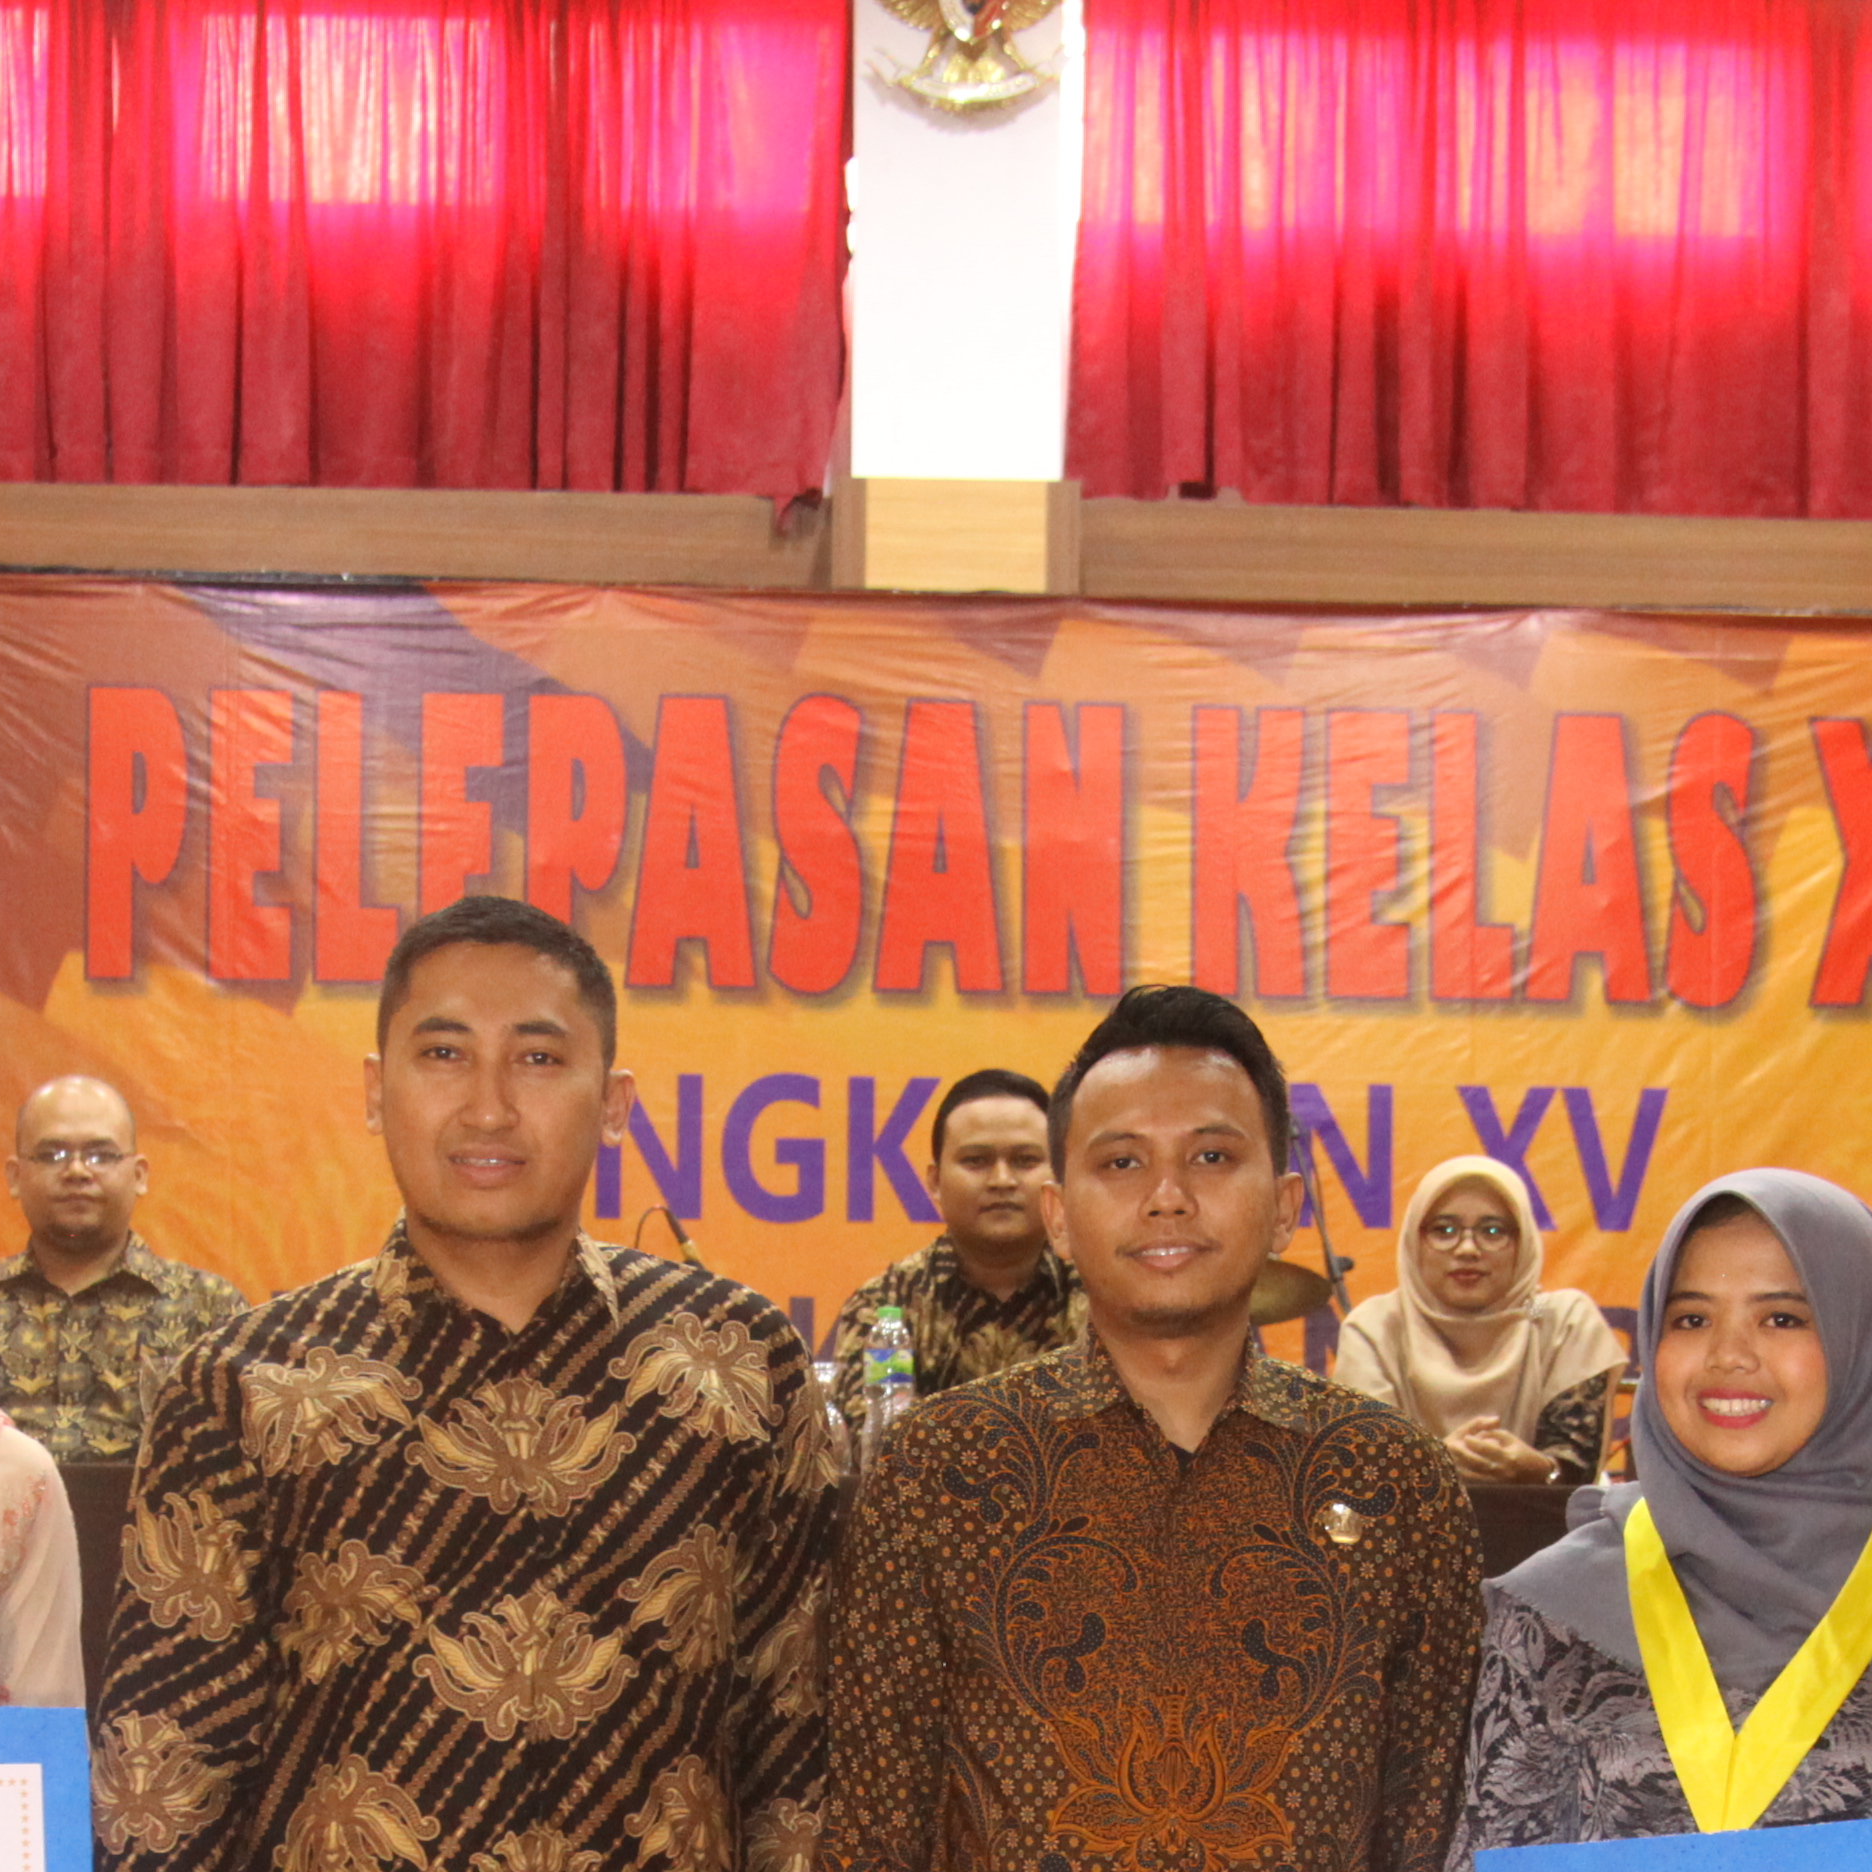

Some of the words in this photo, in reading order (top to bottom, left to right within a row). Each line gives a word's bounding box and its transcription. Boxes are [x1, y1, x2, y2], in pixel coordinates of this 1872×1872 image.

[84, 685, 1126, 998] PELEPASAN
[1190, 704, 1760, 1010] KELAS
[1457, 1085, 1669, 1232] XV
